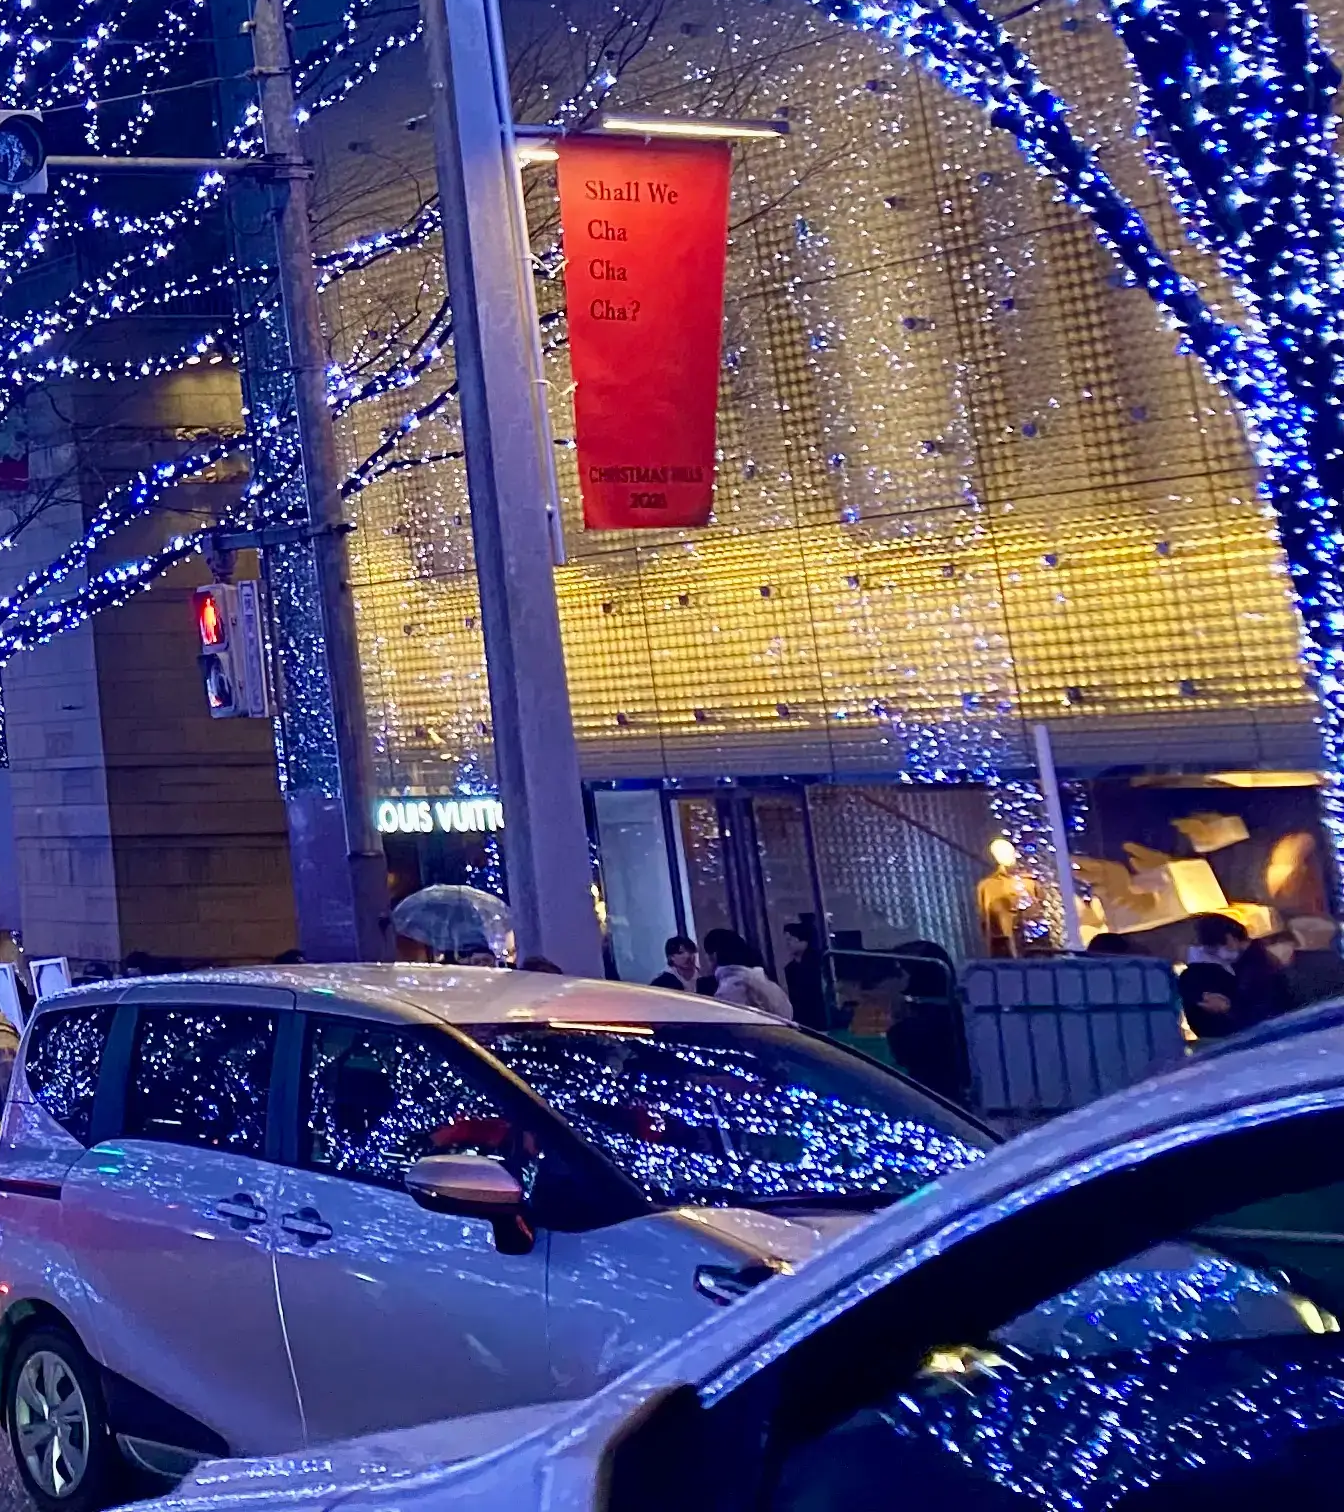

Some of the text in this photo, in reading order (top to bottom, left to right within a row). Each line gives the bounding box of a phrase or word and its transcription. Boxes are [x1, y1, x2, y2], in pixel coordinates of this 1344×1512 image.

[585, 179, 678, 205] Shall We
[587, 219, 628, 242] Cha
[589, 258, 628, 281] Cha
[590, 298, 641, 322] Cha?
[378, 800, 433, 833] OUIS
